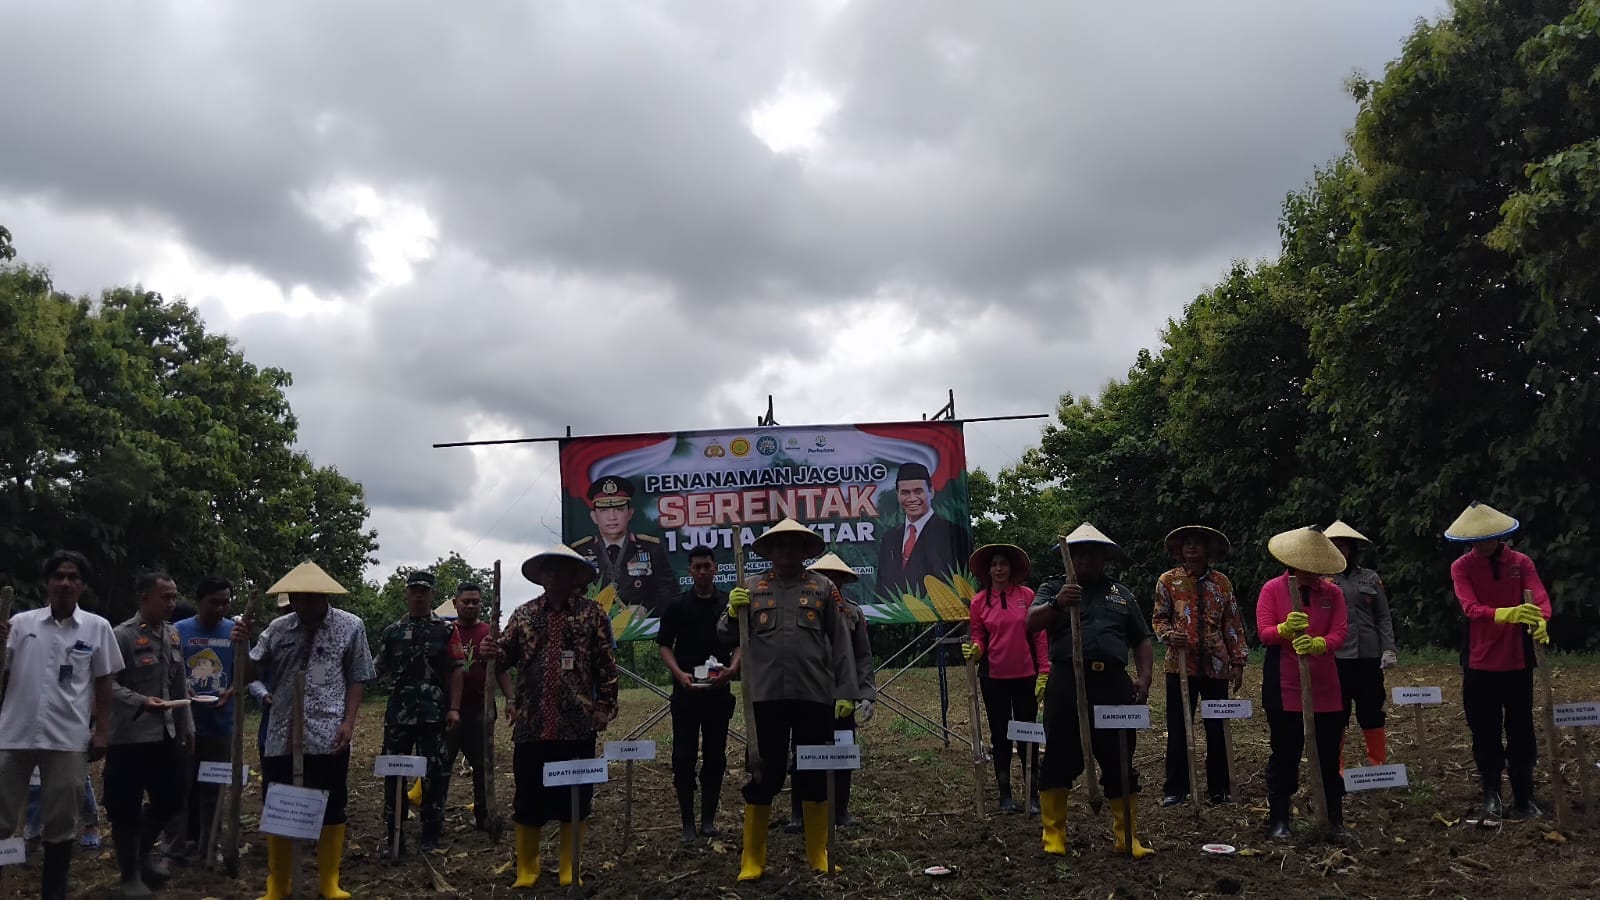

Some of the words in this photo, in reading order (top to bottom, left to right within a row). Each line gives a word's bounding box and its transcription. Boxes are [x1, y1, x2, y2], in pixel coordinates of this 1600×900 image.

[646, 467, 791, 493] PENANAMAN
[793, 464, 887, 485] JAGUNG
[658, 486, 880, 528] SERENTAK
[664, 531, 678, 552] 1
[682, 527, 755, 552] JUTA
[572, 767, 604, 776] REMBANG
